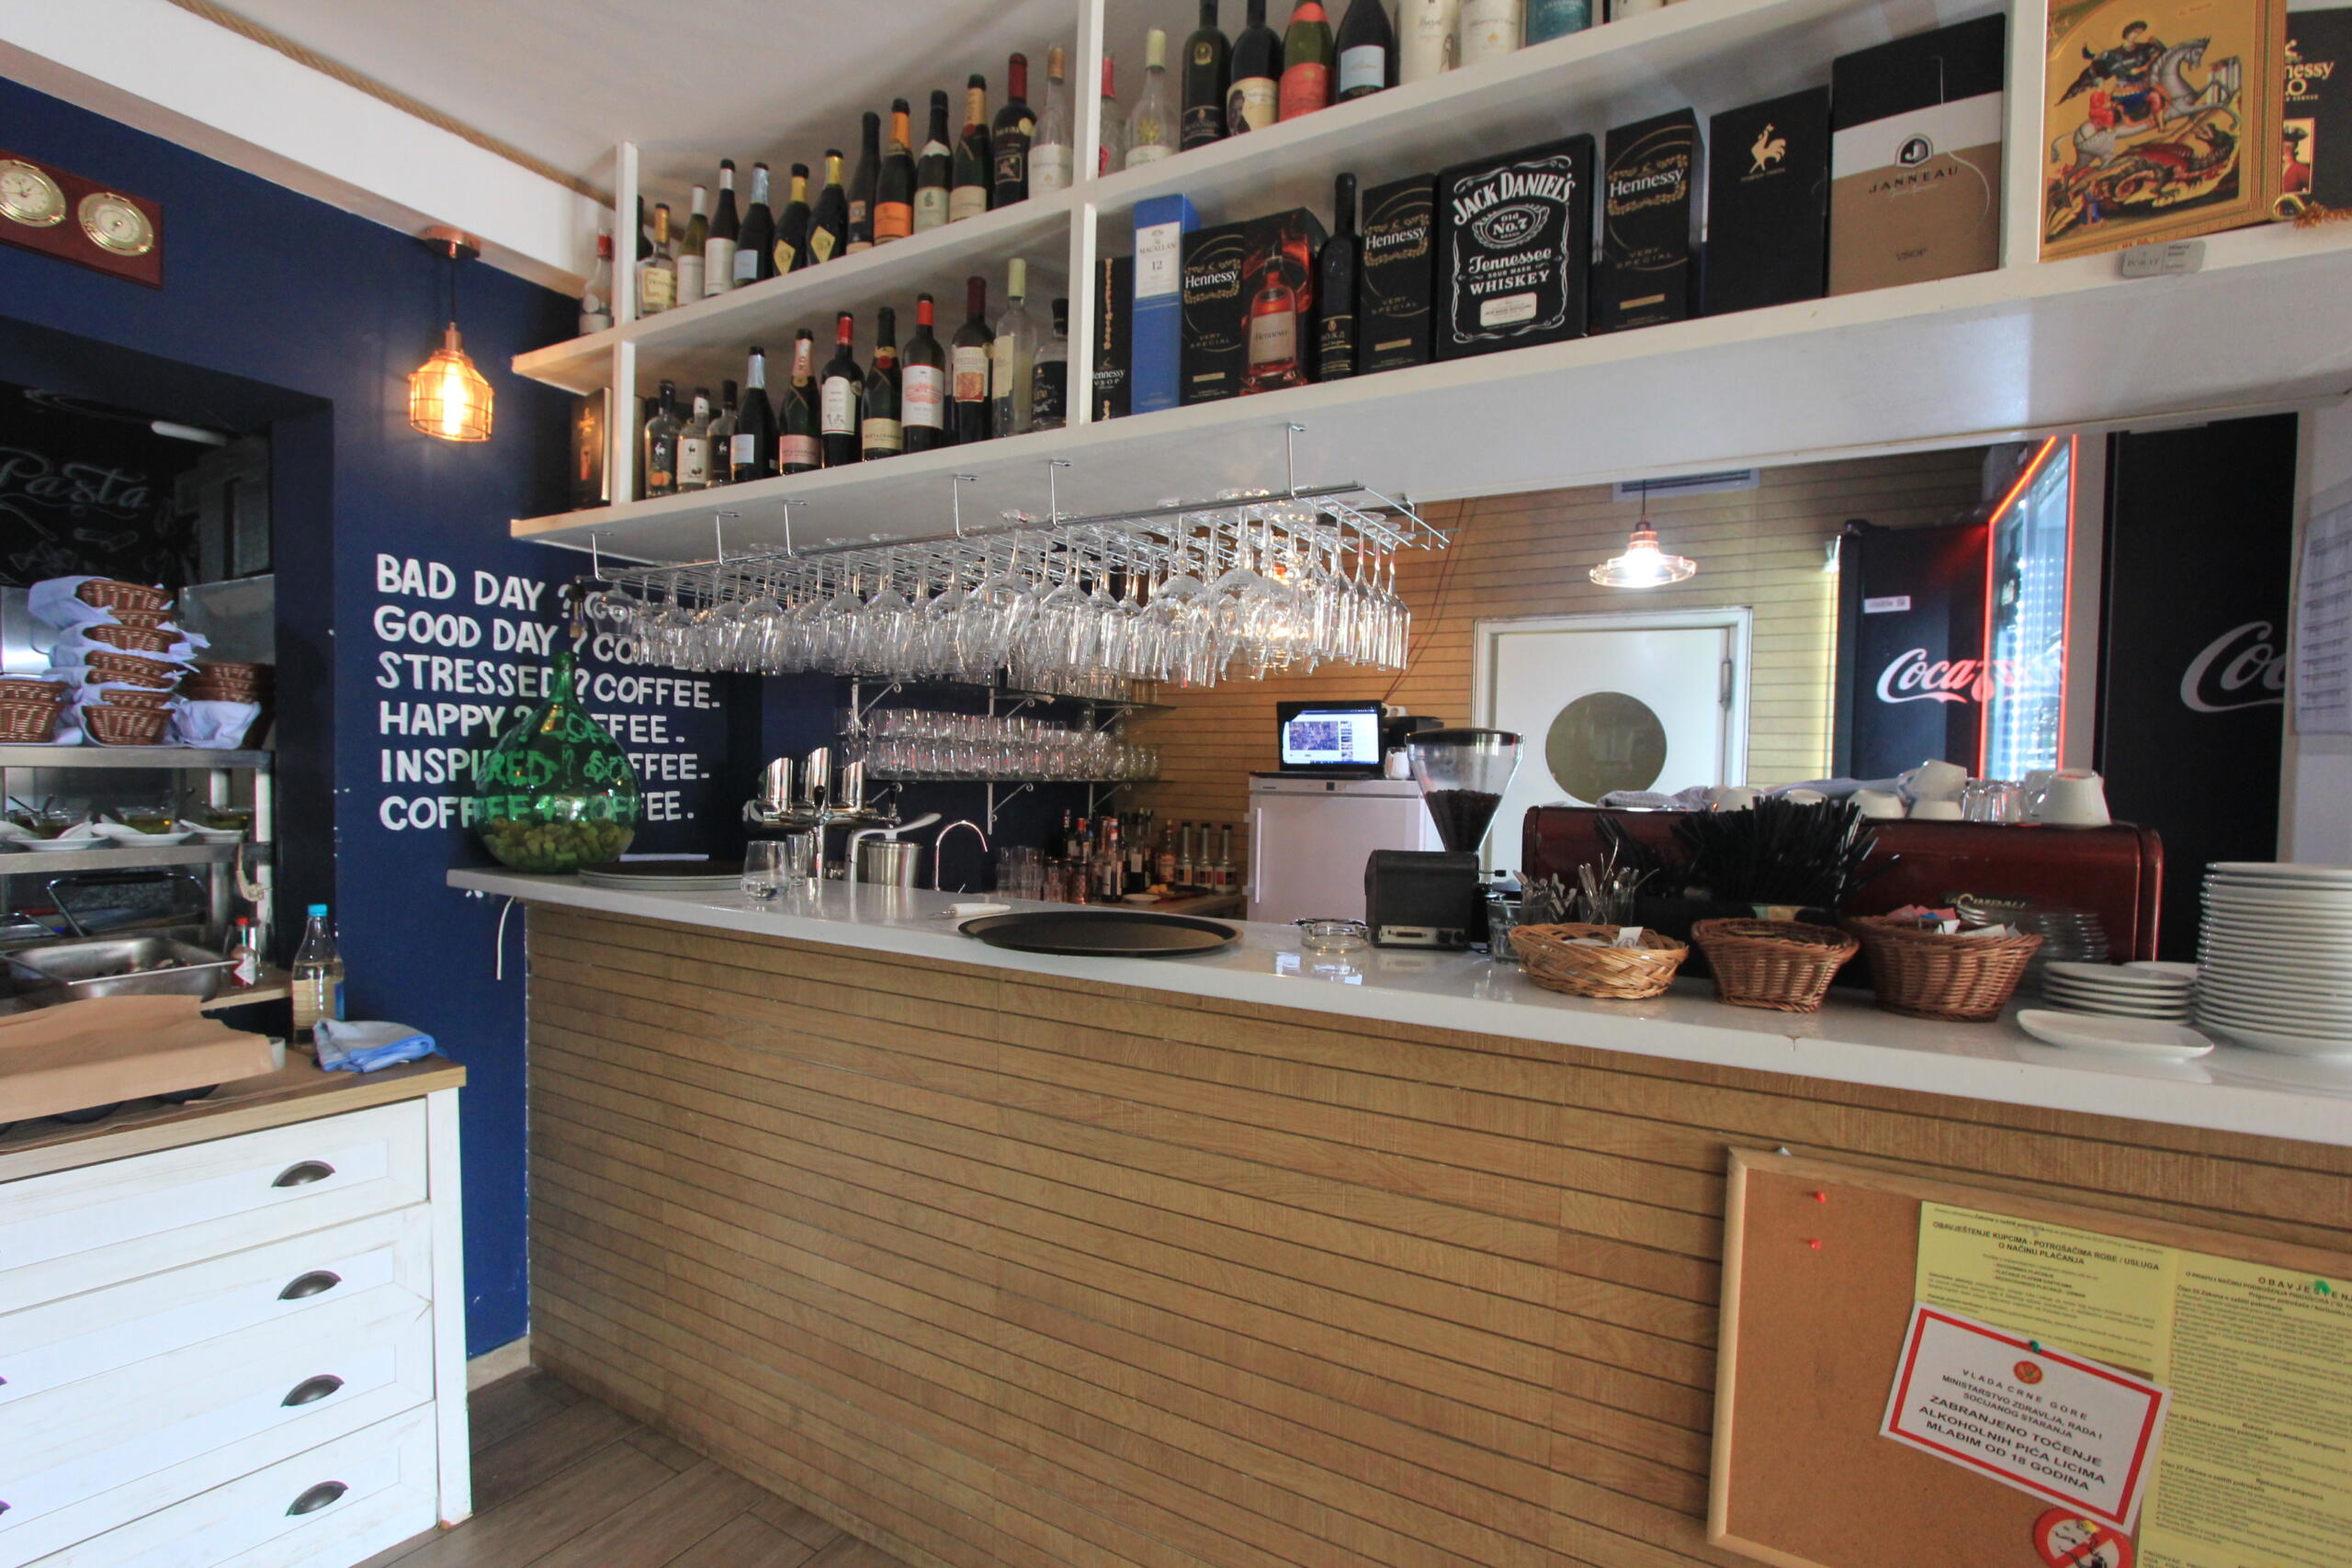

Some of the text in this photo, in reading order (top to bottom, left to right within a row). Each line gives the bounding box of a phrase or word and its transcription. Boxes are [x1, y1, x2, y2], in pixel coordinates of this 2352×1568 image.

[1610, 168, 1685, 197] Hennessy
[1868, 166, 1958, 194] JANNEAU
[1452, 172, 1577, 226] JACK DANIEL'S
[1365, 227, 1427, 251] Hennessy
[1184, 269, 1238, 289] Hennessy
[1468, 248, 1552, 275] Tennessee
[1470, 269, 1551, 296] WHISKEY
[1093, 369, 1125, 379] ennessy
[377, 553, 457, 600] BAD
[474, 570, 546, 612] DAY
[374, 605, 482, 649] GOOD
[492, 618, 559, 657] DAY
[594, 672, 721, 709] COFFEE.
[379, 701, 506, 738] HAPPY
[1992, 1231, 2028, 1245] KUPCIMA
[2093, 1251, 2119, 1263] ROBE
[2123, 1258, 2160, 1271] USLUGA
[1941, 1374, 2011, 1404] MINISTARSTVO
[2067, 1422, 2098, 1438] RADA
[1962, 1368, 2088, 1421] VLADA CRNE GORE
[1929, 1394, 2028, 1438] ZABRANJENO
[2020, 1413, 2074, 1439] STARANJA
[1918, 1405, 2012, 1447] ALKOHOLNIH
[2053, 1457, 2107, 1484] LICIMA
[1984, 1443, 2007, 1458] OD
[2011, 1454, 2027, 1466] 18
[2030, 1461, 2090, 1492] GODINA
